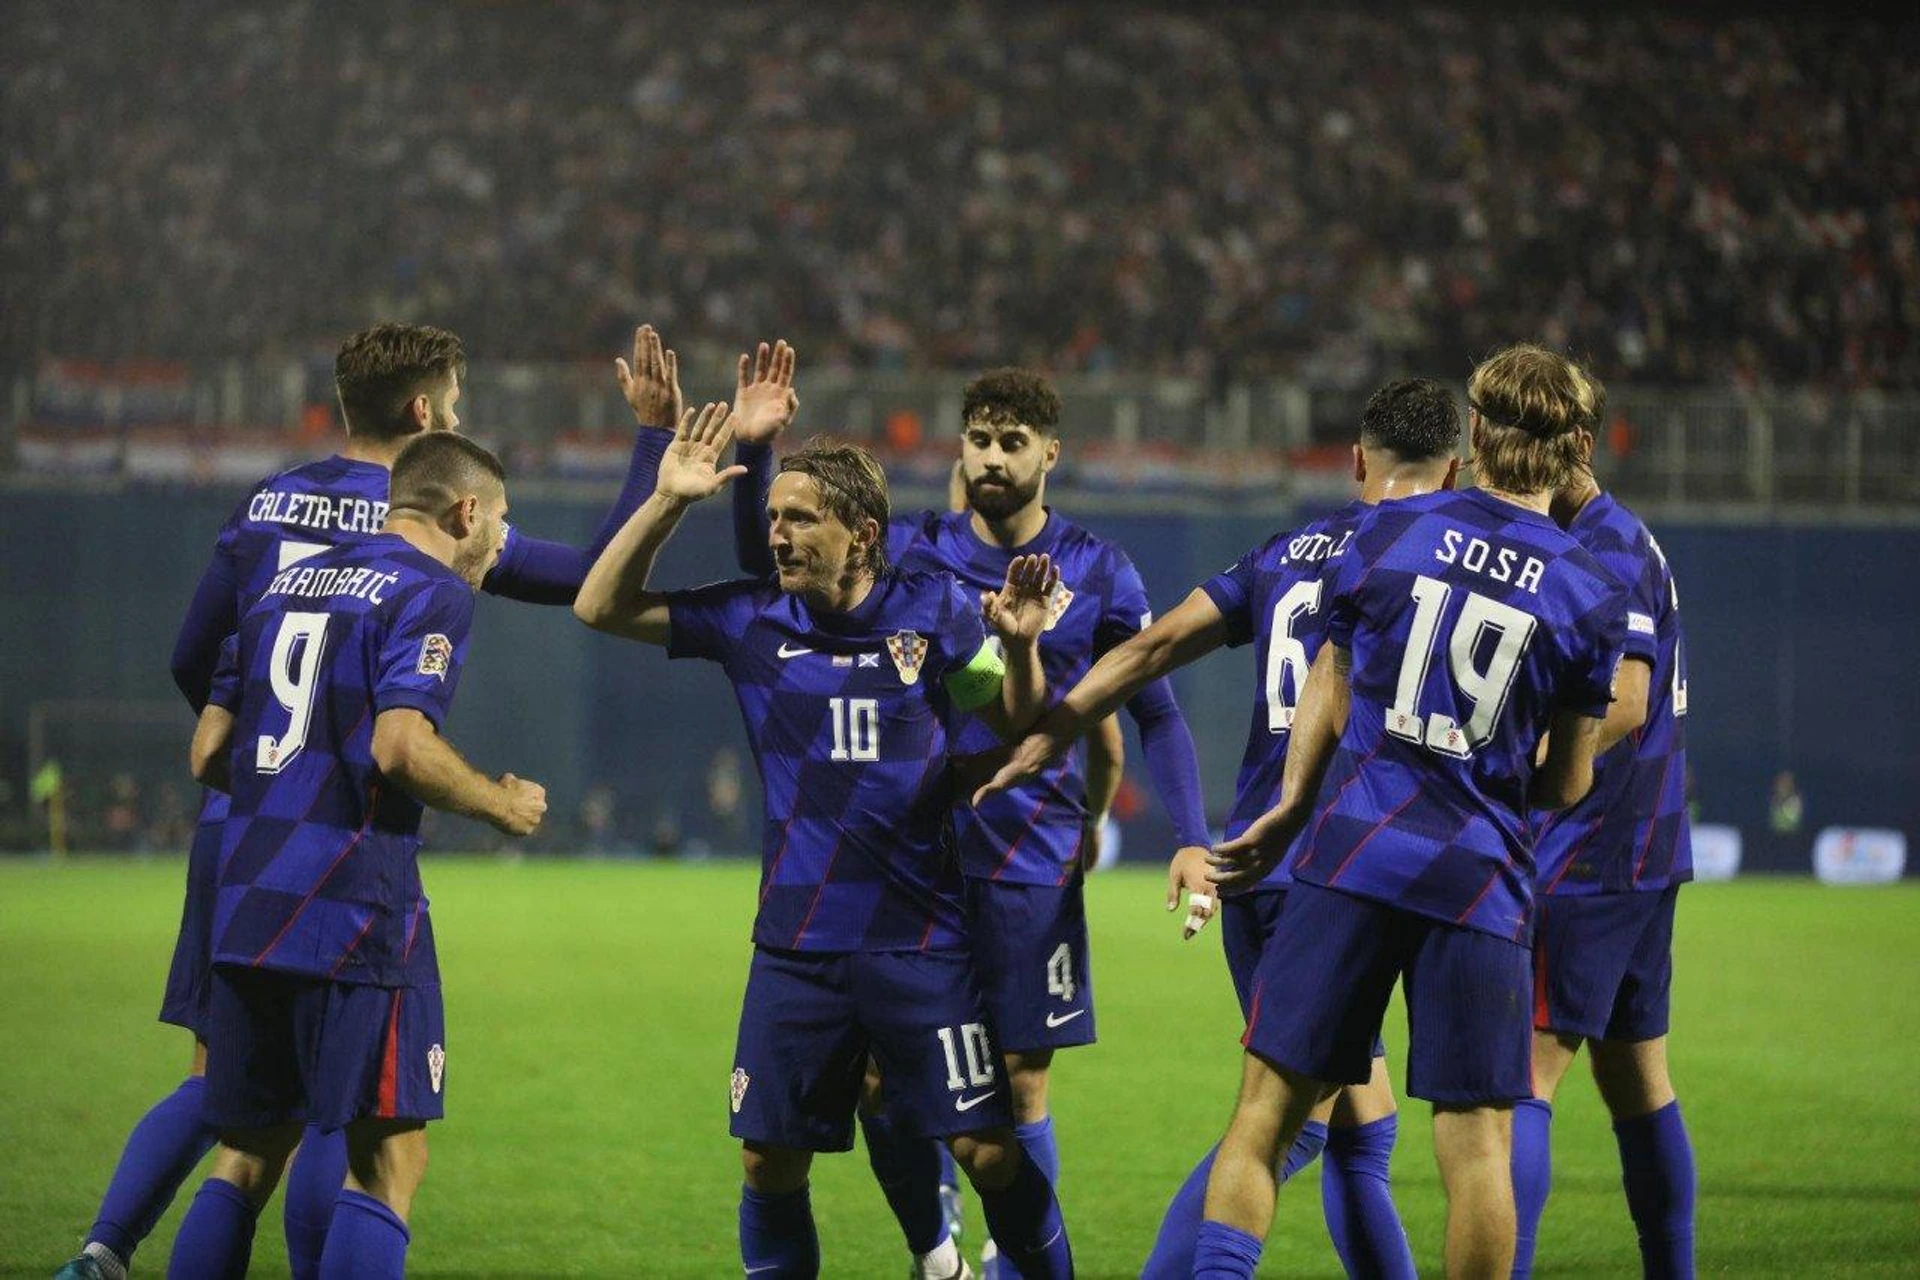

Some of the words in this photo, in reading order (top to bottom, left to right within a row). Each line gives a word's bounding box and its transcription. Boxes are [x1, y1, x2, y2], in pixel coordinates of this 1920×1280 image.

[1435, 529, 1545, 594] SOSA
[1266, 579, 1323, 735] 6
[1385, 574, 1538, 760] 19
[256, 611, 331, 774] 9
[829, 697, 879, 762] 10
[1047, 943, 1076, 1002] 4
[937, 1022, 995, 1091] 10
